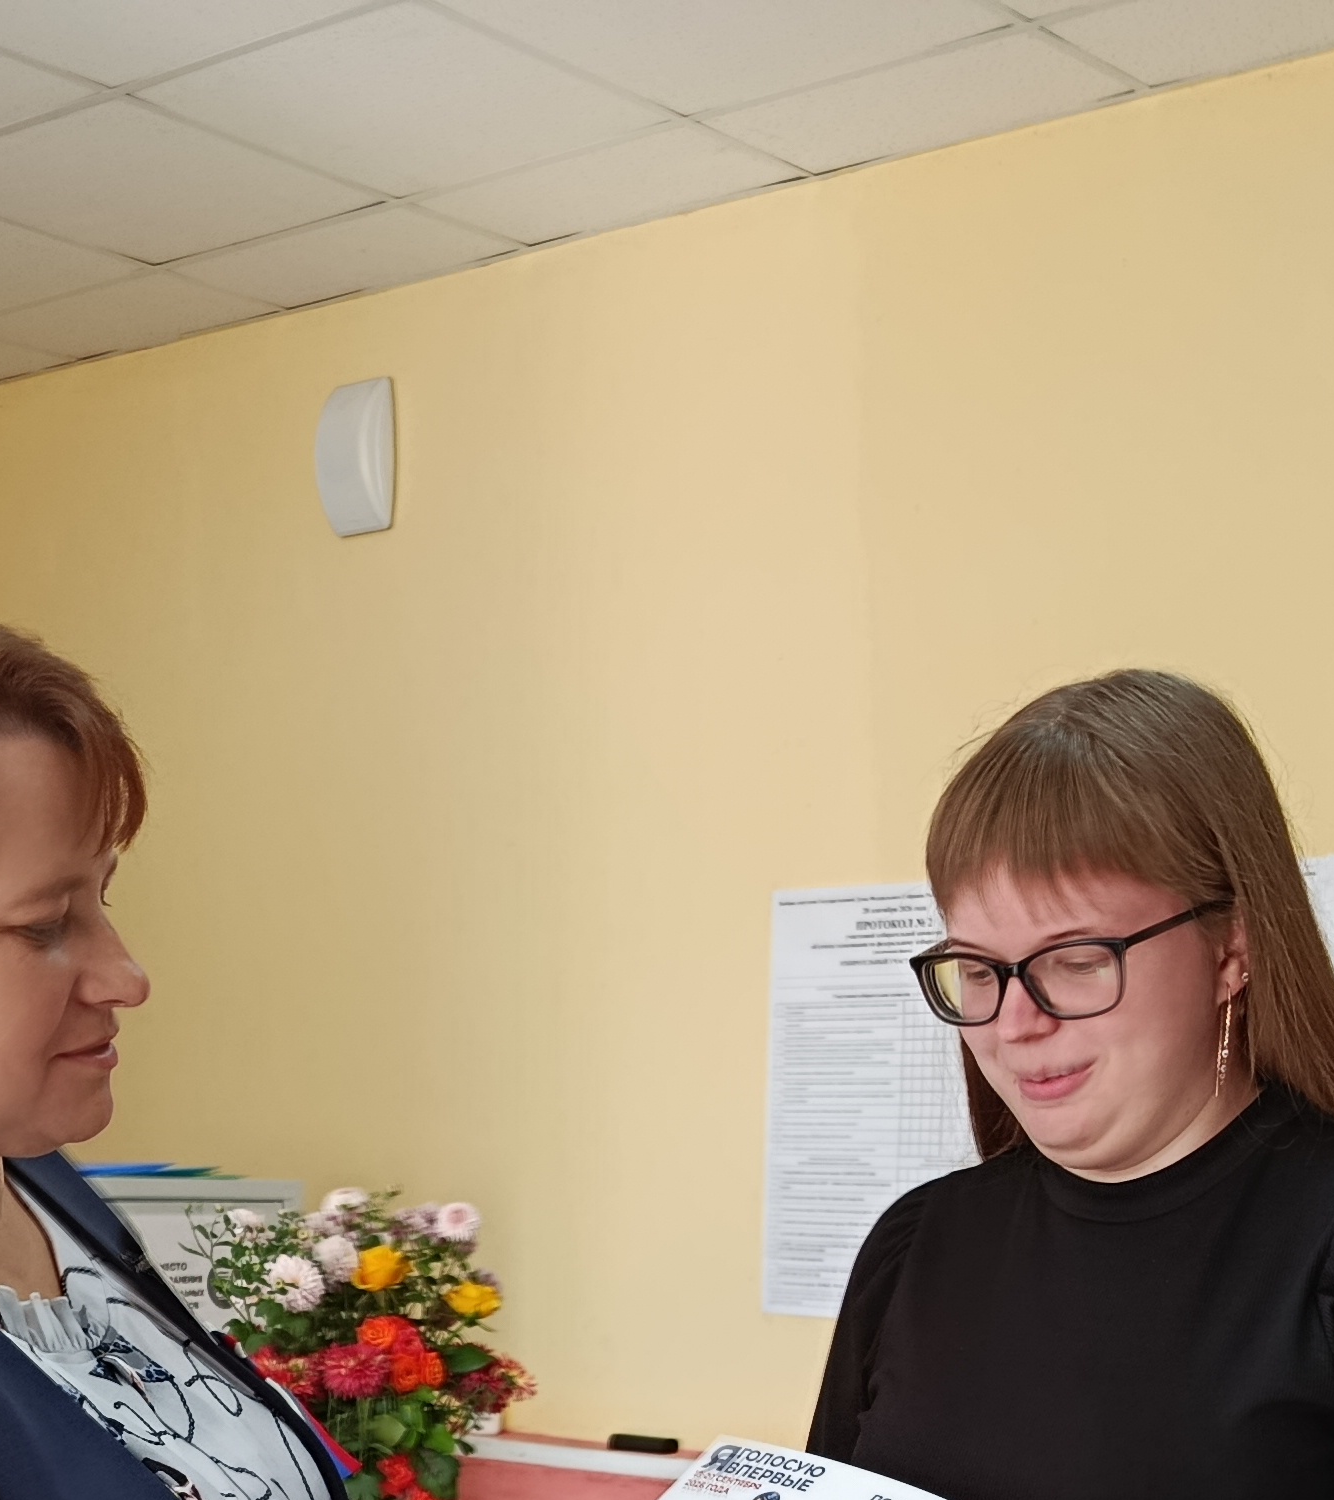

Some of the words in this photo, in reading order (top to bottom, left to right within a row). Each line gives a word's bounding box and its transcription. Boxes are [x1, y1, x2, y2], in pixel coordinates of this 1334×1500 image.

[855, 918, 914, 930] ПРОТОКОЛ
[916, 918, 927, 927] №
[701, 1444, 742, 1472] Я
[736, 1447, 826, 1478] ГОЛОСУЮ
[724, 1461, 814, 1492] ВПЕРВЫЕ
